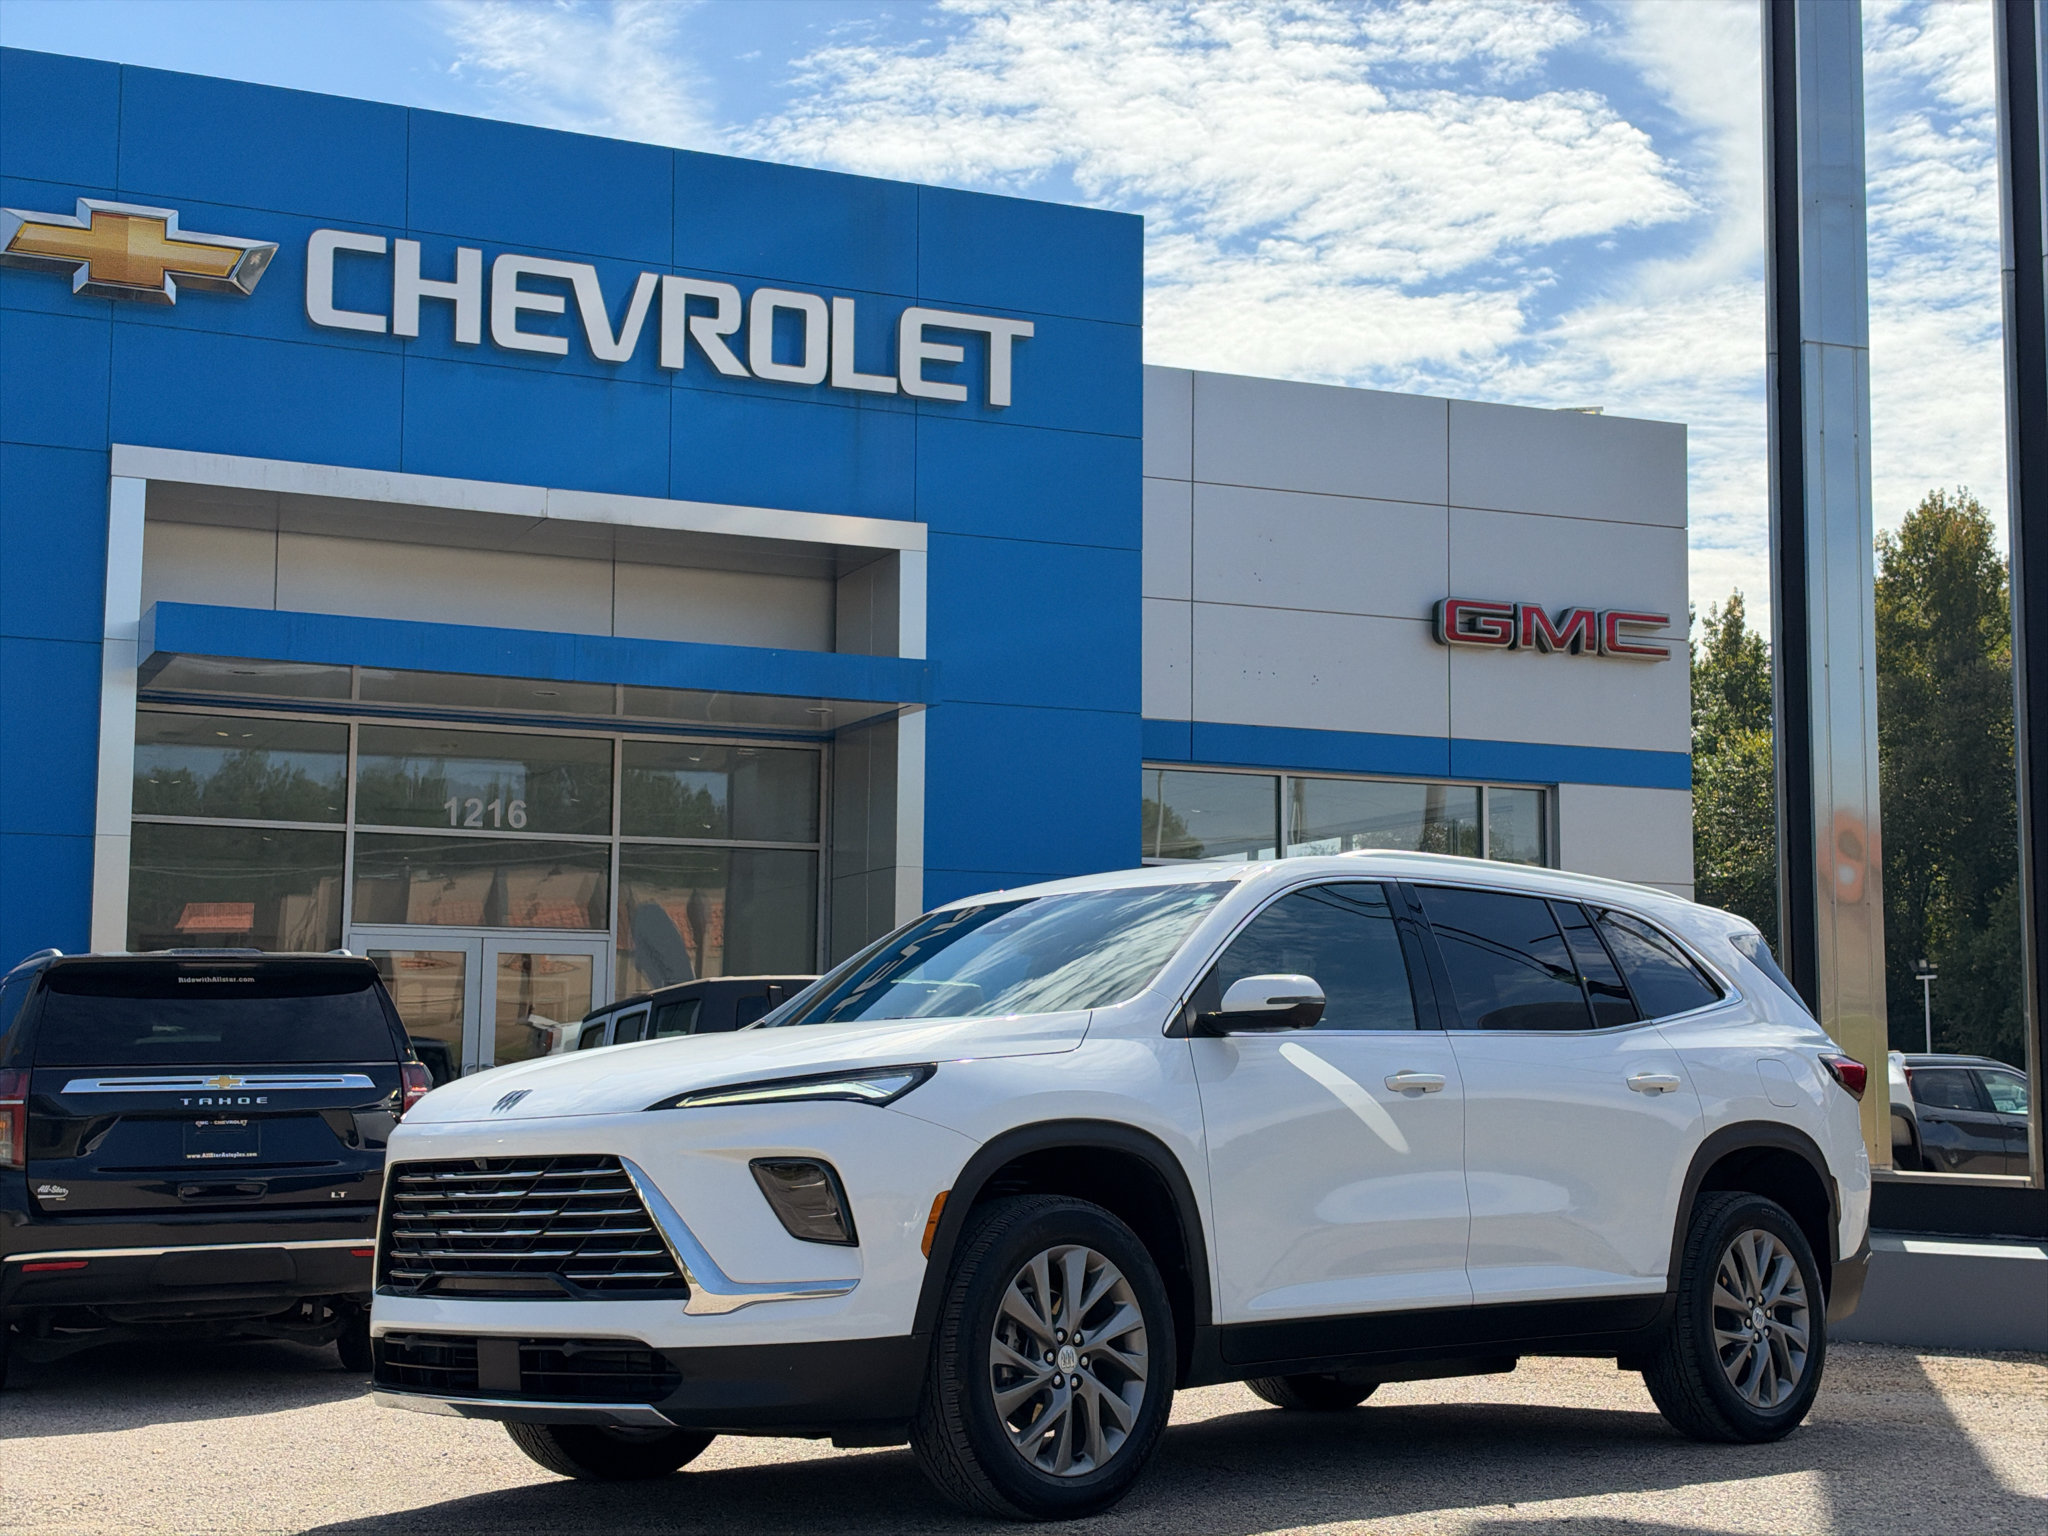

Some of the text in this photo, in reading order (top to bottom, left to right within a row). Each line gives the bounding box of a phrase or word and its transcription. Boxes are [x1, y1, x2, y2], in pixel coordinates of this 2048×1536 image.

[306, 228, 1035, 407] CHEVROLET
[1433, 597, 1671, 661] GMC
[444, 796, 527, 829] 1216
[180, 1096, 268, 1105] TAHOE
